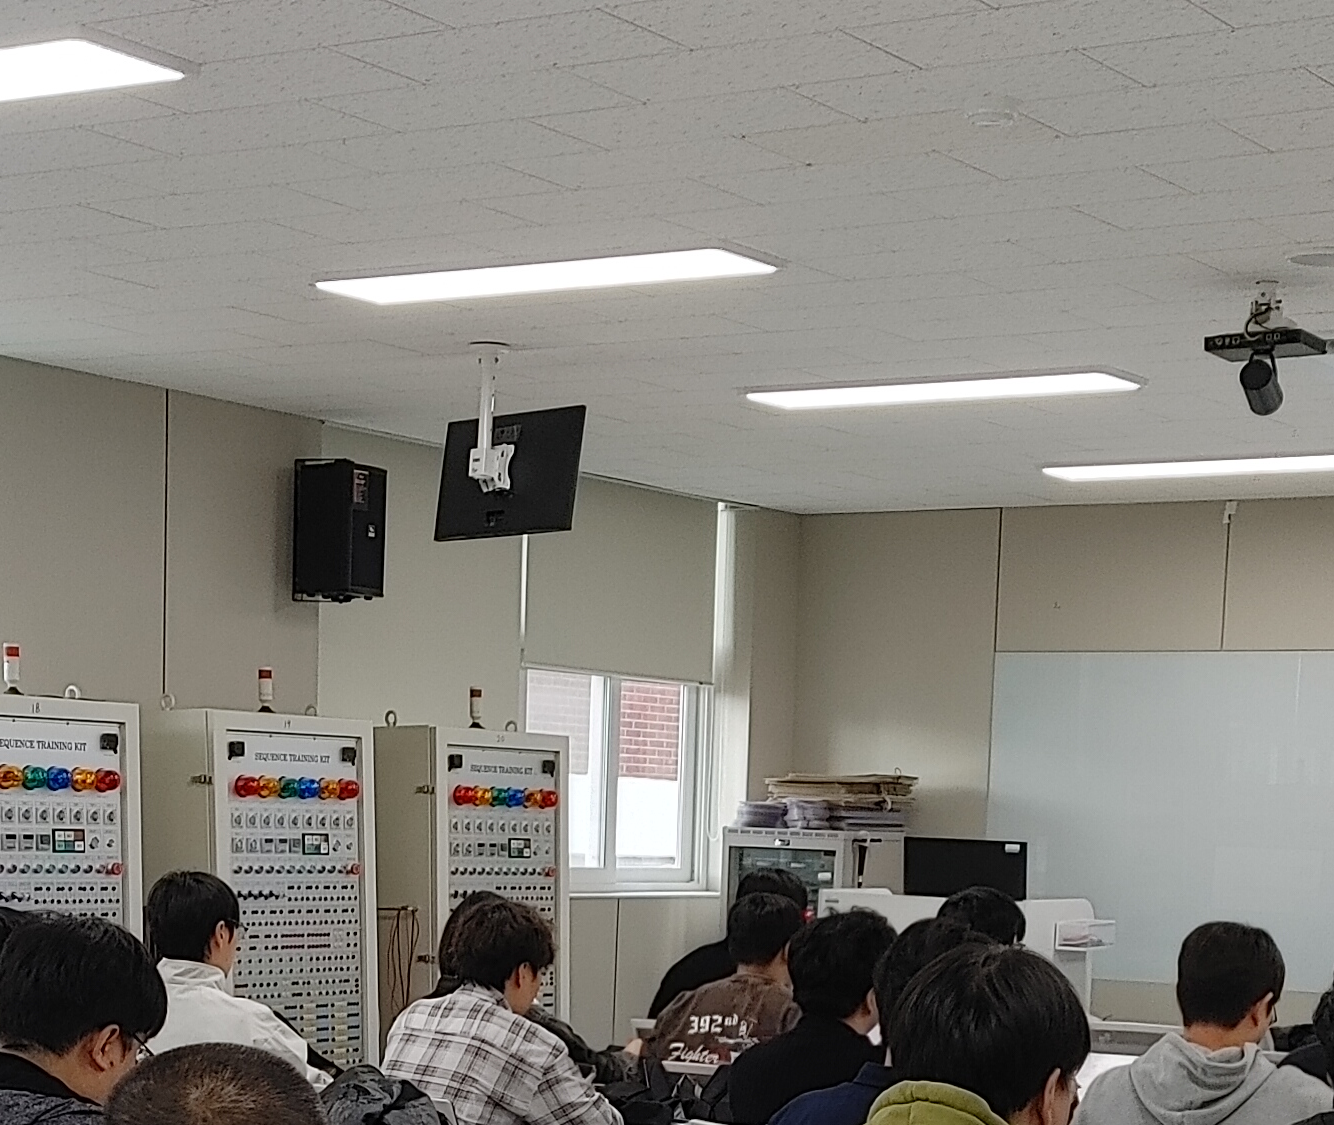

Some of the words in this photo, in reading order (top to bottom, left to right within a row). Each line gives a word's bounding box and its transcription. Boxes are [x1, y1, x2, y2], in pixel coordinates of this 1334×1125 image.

[31, 702, 41, 714] 18
[36, 740, 73, 751] TRAINING
[74, 742, 87, 752] KIT
[254, 752, 288, 763] SEQUENCE
[288, 753, 319, 763] TRAINING
[668, 1042, 720, 1064] Fighter
